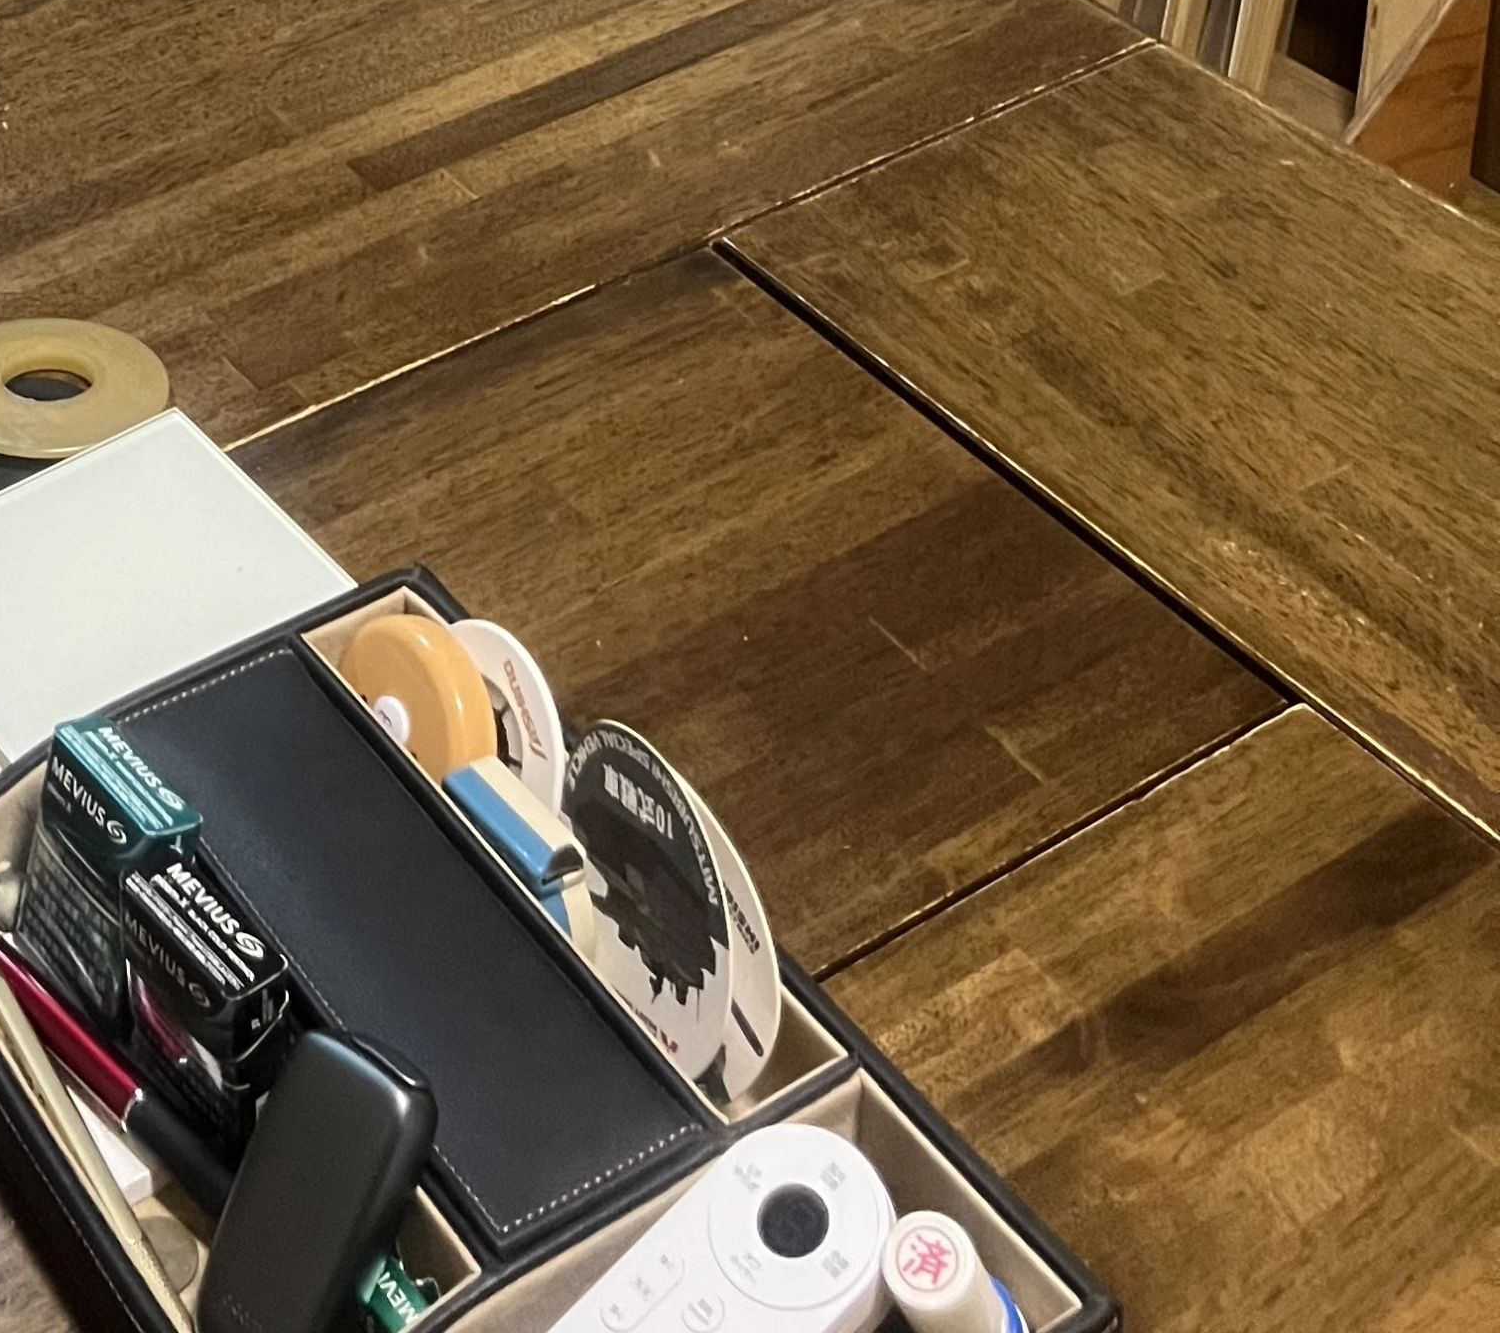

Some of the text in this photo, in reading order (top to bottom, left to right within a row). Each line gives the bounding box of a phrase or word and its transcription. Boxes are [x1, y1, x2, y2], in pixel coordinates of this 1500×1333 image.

[51, 756, 106, 827] MEVIUS
[98, 727, 162, 788] MEVIUS
[166, 862, 240, 935] MEVIUS
[124, 909, 187, 987] MEVIUS
[377, 1271, 419, 1326] MEVI
